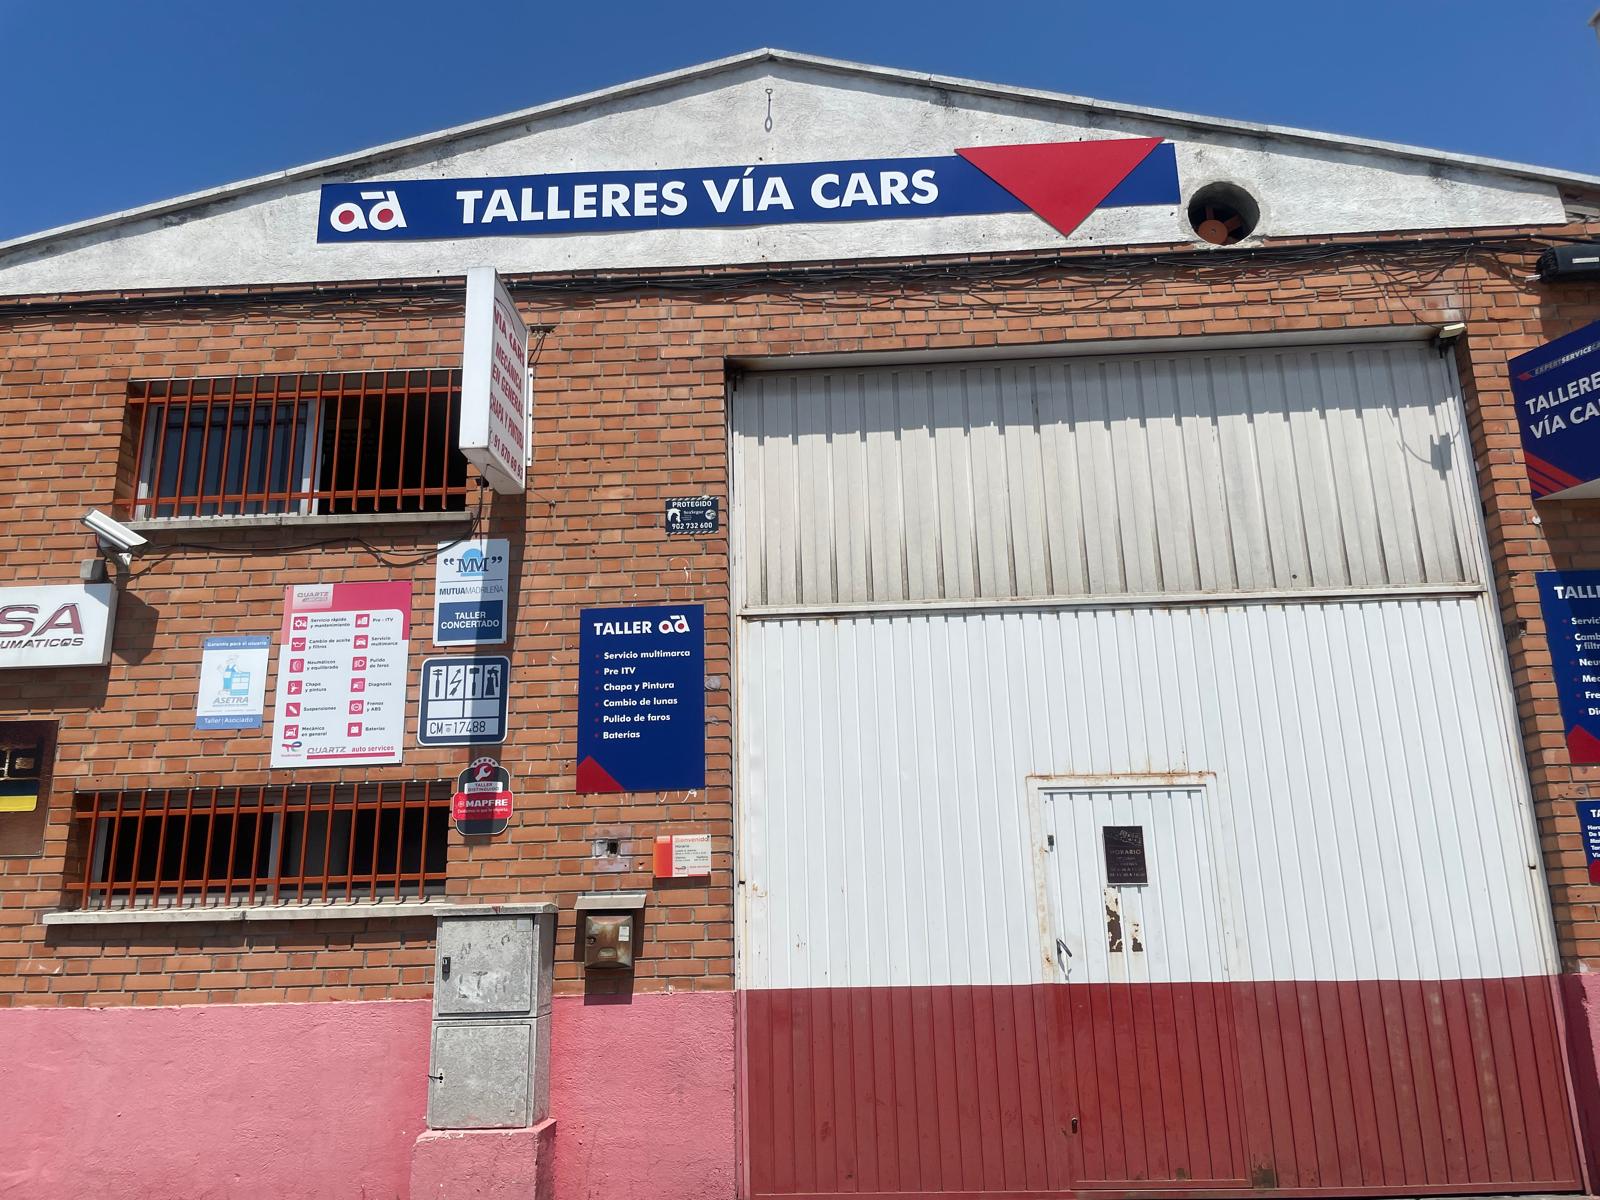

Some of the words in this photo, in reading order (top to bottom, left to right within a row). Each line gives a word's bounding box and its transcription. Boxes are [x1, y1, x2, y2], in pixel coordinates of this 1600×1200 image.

[456, 180, 688, 224] TALLERES
[703, 166, 795, 214] VÍA
[810, 169, 939, 209] CARS
[495, 341, 522, 394] MECÁNICA
[492, 363, 501, 386] EN
[501, 375, 524, 420] GENERAL
[1529, 414, 1567, 439] VÍA
[1570, 398, 1600, 424] CA
[672, 500, 712, 508] PROTEGIDO
[439, 585, 504, 596] MUTUAMADRILEÑA
[454, 611, 487, 620] TALLER
[440, 619, 500, 629] CONCERTADO
[593, 621, 652, 636] TALLER
[1575, 643, 1582, 652] y
[603, 651, 638, 660] Servicio
[640, 649, 691, 658] multimarca
[603, 667, 619, 675] Pre
[621, 666, 636, 674] ITV
[603, 683, 633, 692] Chapa
[634, 684, 640, 692] y
[642, 681, 675, 690] Pintura
[603, 698, 637, 707] Cambio
[639, 697, 651, 706] de
[653, 697, 678, 705] lunas
[603, 714, 632, 723] Pulido
[633, 713, 645, 722] de
[647, 712, 671, 721] faros
[602, 730, 641, 740] Baterías
[306, 746, 347, 754] QUARTZ
[465, 798, 509, 808] MAPFRE
